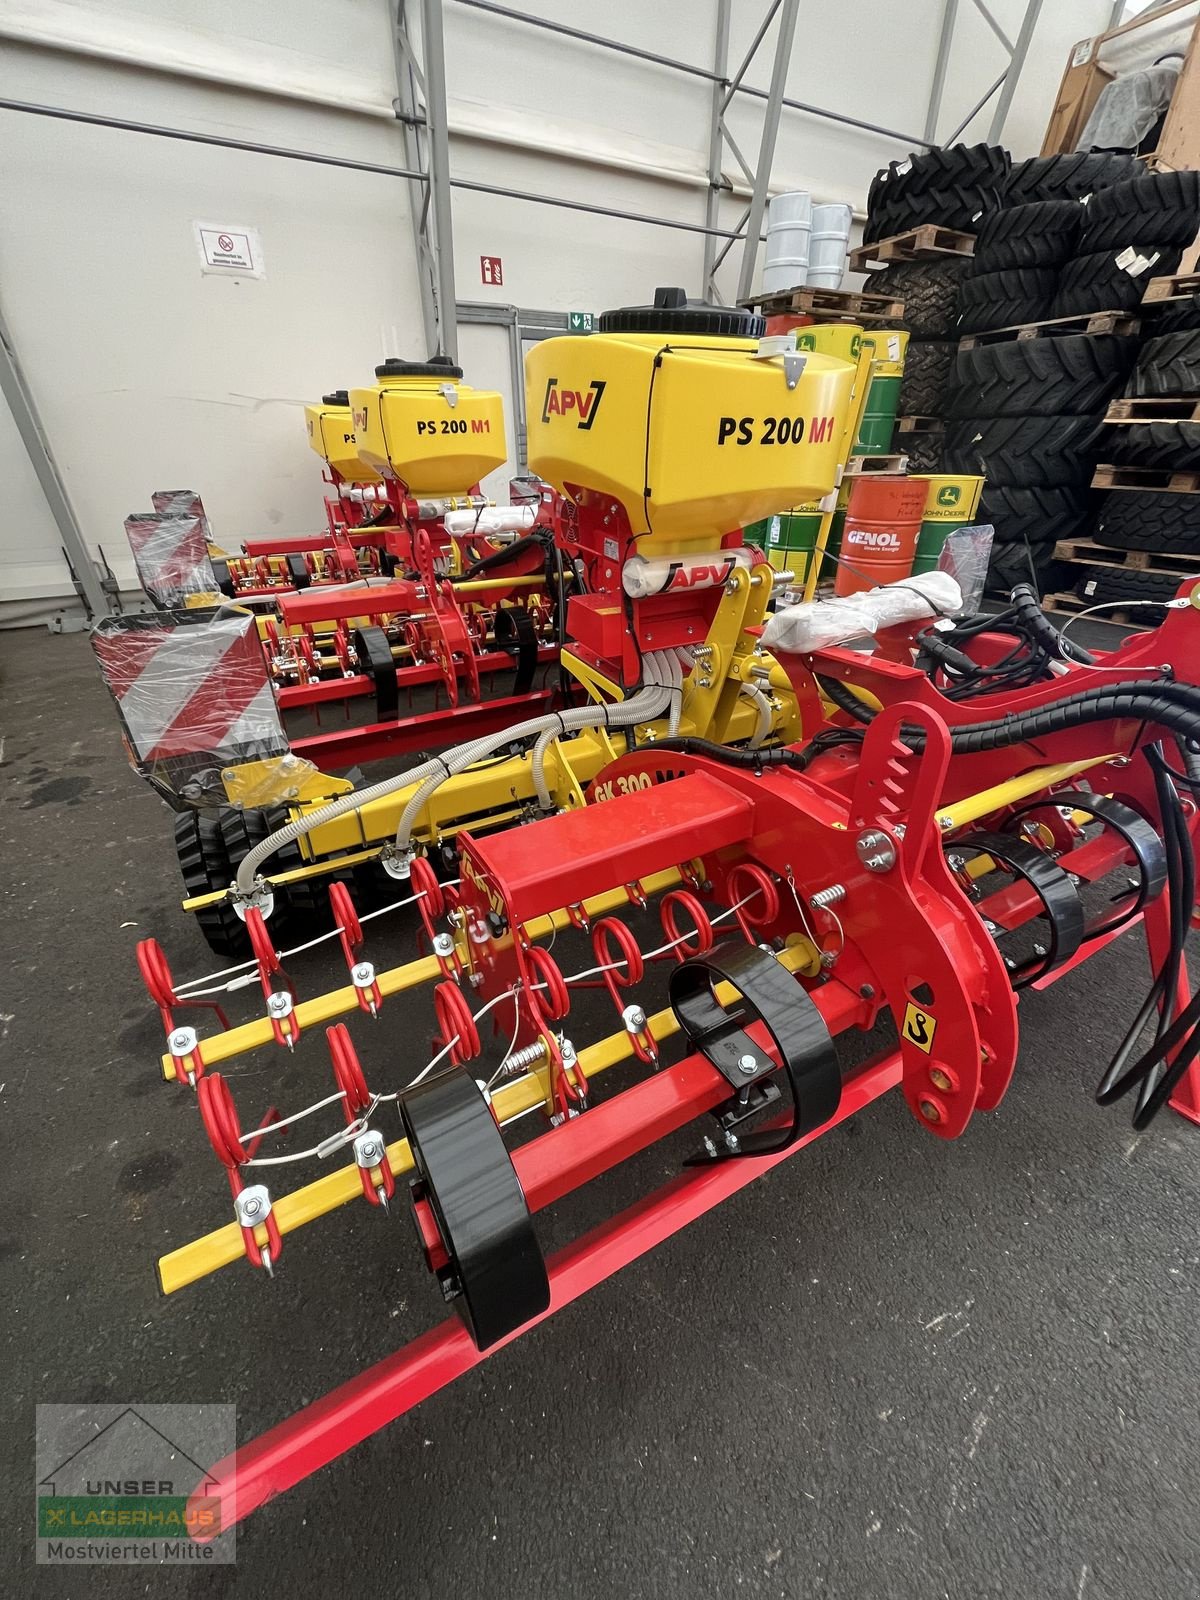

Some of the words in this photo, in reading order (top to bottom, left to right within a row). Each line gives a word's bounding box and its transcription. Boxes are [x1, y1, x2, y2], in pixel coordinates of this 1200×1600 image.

[417, 421, 436, 434] PS
[441, 420, 467, 434] 200
[471, 420, 490, 433] M1
[717, 417, 754, 445] PS
[760, 417, 805, 444] 200
[809, 416, 834, 444] M1
[344, 434, 356, 443] PS
[847, 530, 901, 546] GENOL
[595, 781, 615, 803] GK
[617, 772, 653, 796] 300
